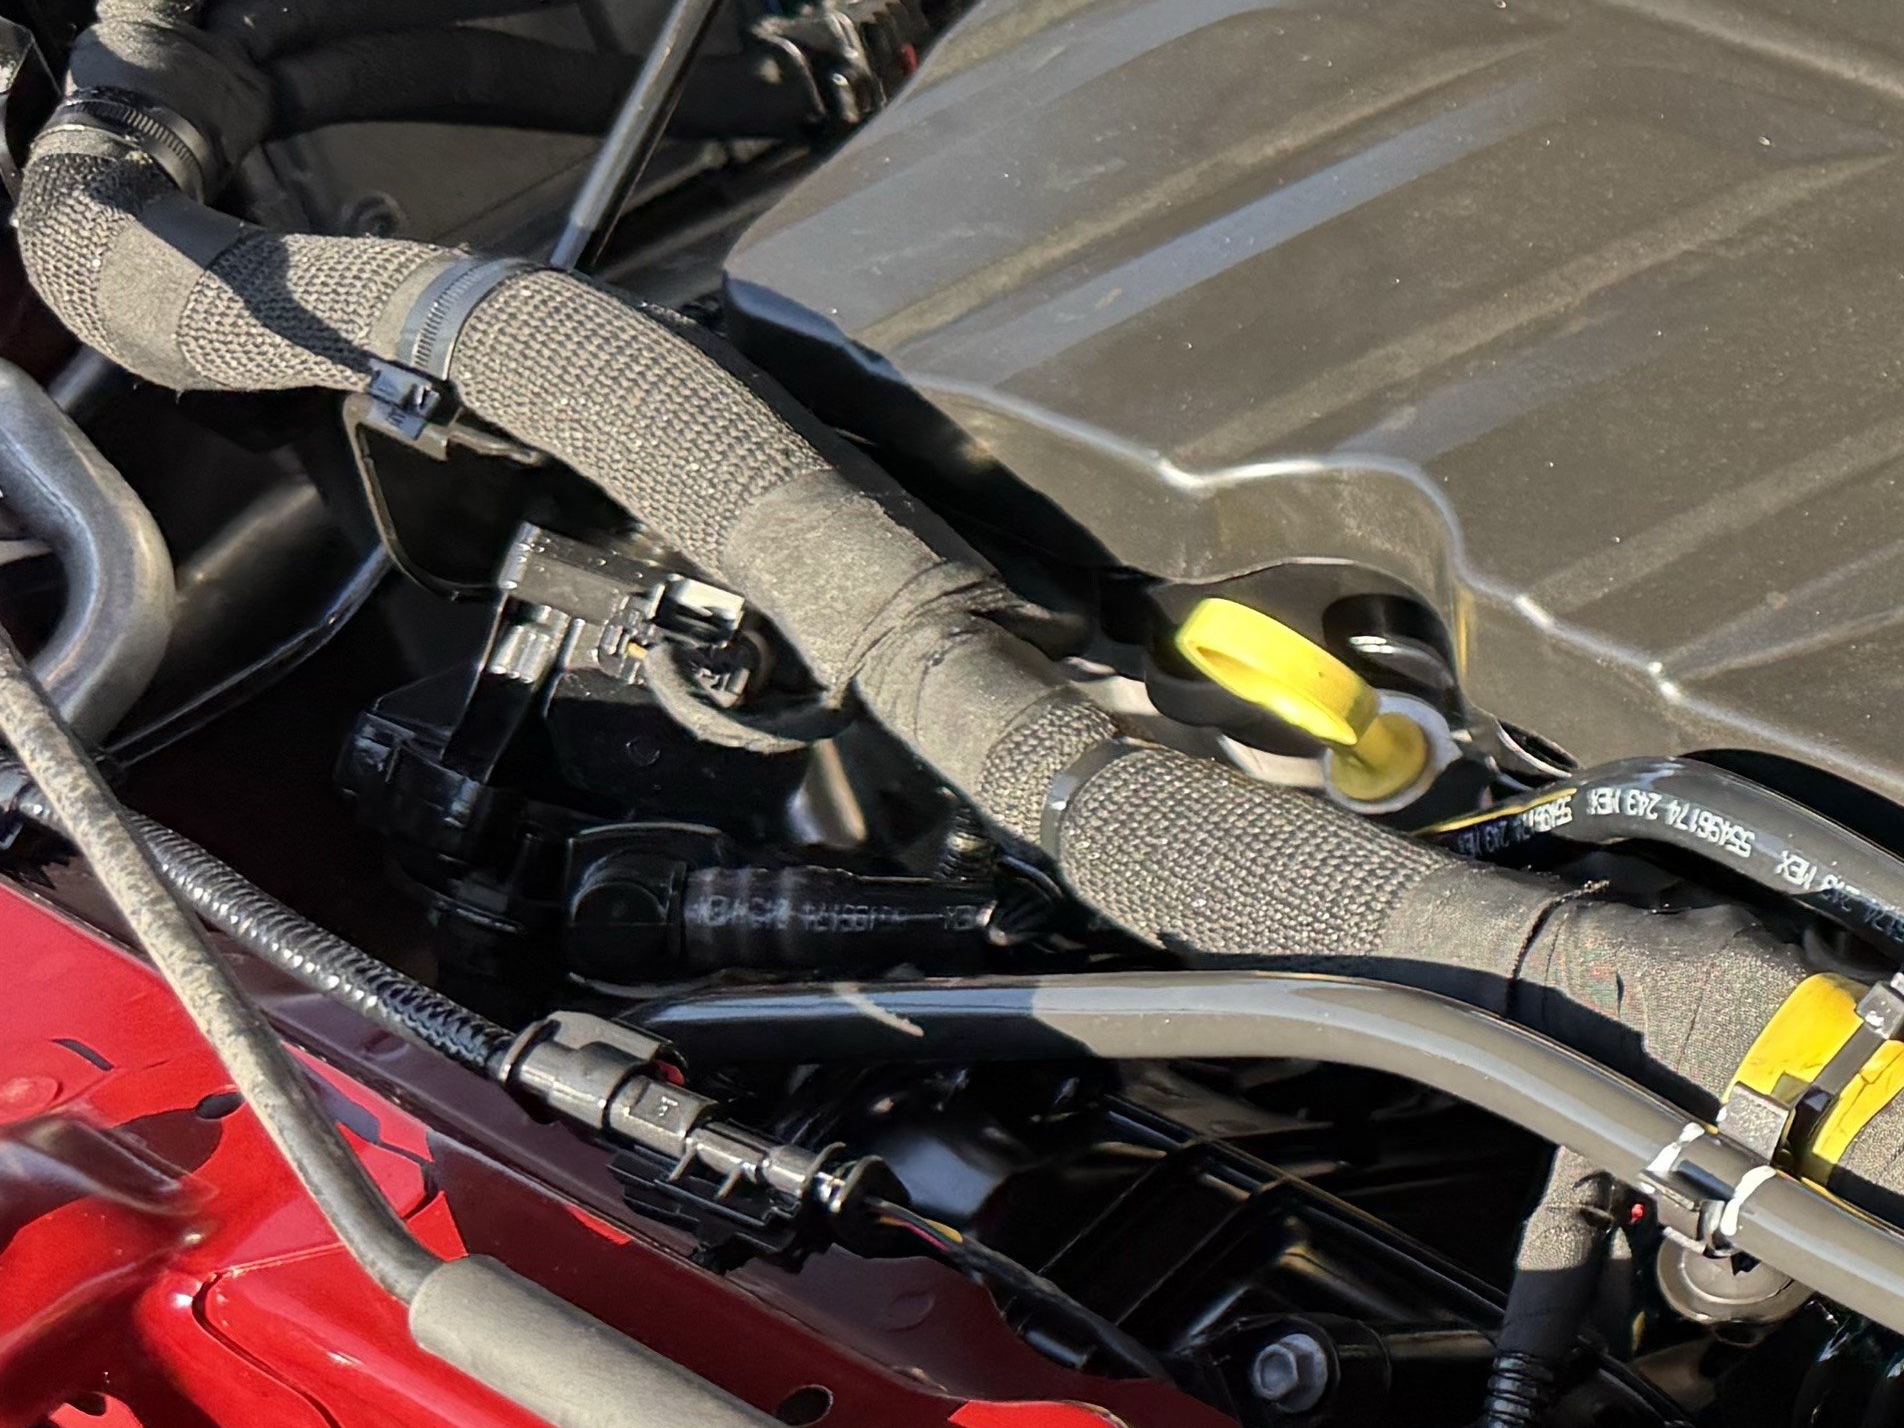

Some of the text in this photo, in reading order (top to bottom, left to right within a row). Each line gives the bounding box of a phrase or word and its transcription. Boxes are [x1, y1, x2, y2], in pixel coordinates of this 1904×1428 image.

[1586, 786, 1756, 858] 55496174 243 MEX
[1774, 850, 1818, 891] MEX
